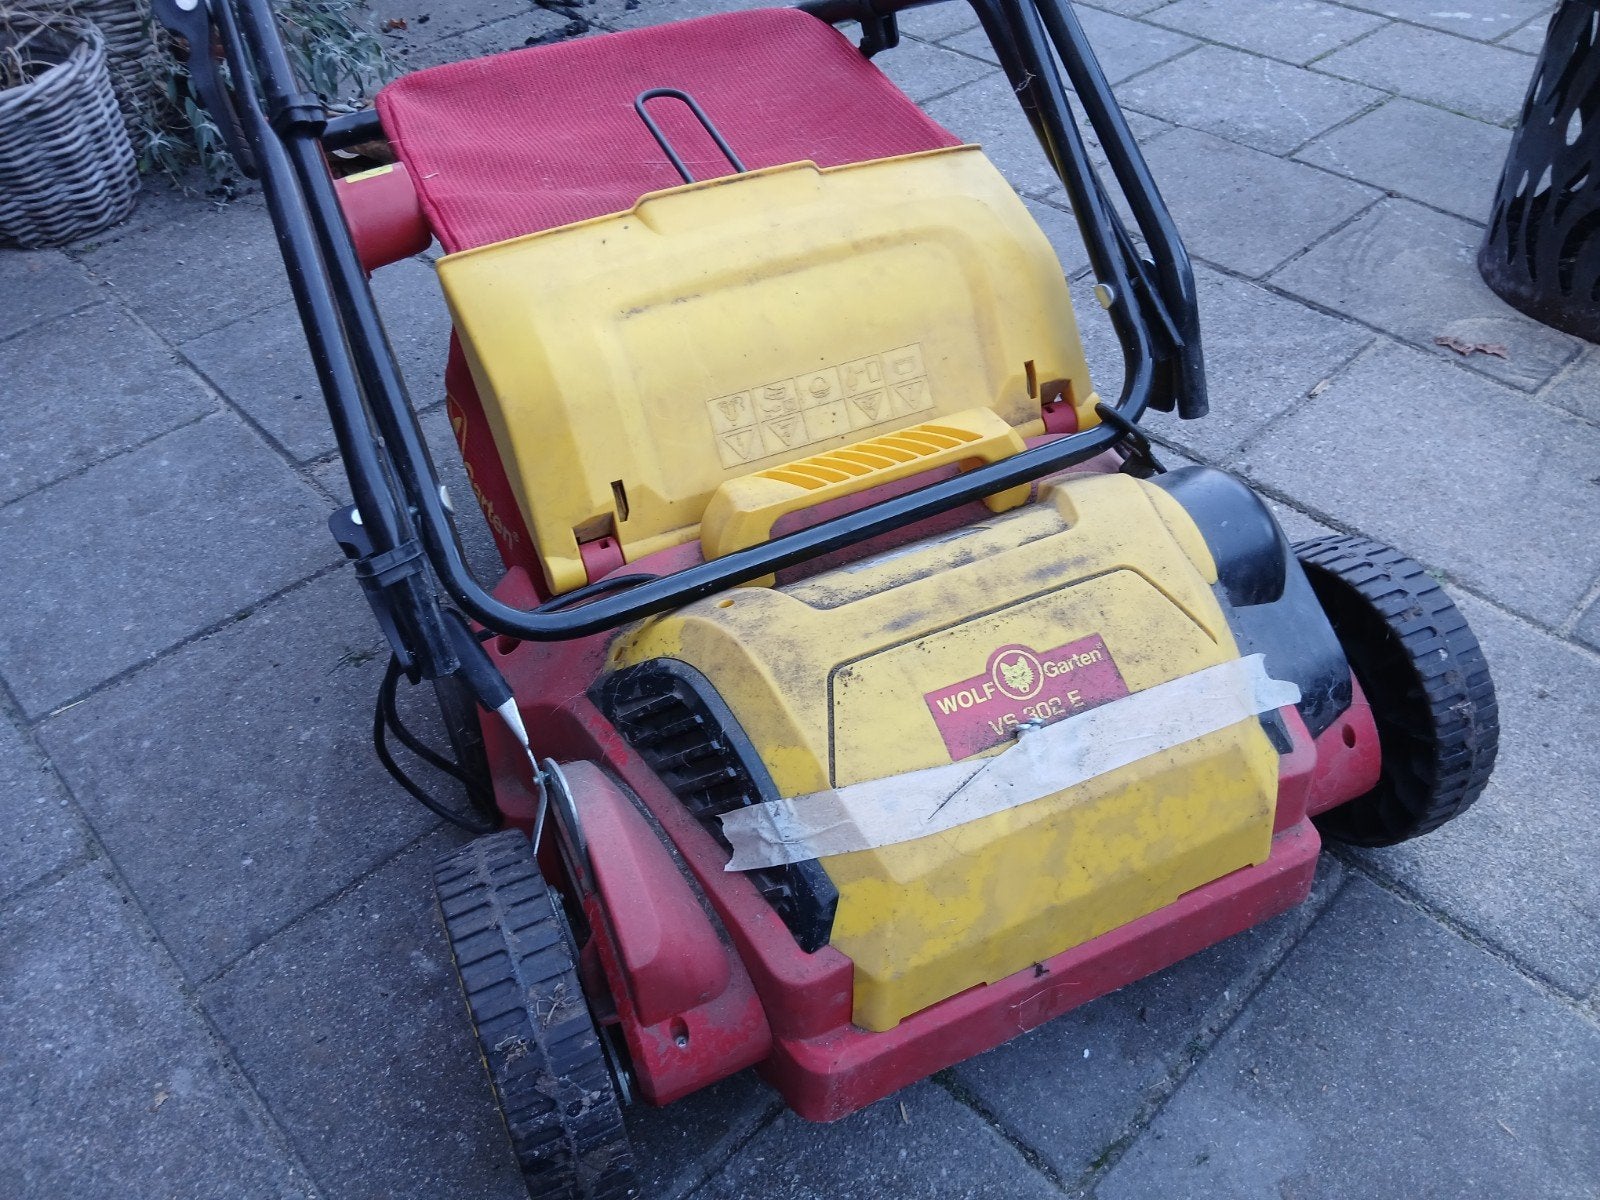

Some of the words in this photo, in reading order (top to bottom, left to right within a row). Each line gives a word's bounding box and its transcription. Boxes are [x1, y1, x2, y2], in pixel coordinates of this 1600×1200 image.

[936, 681, 996, 715] WOLF
[1043, 647, 1104, 678] Garten
[988, 713, 1020, 736] VS
[1022, 696, 1067, 721] 302
[1067, 689, 1086, 708] E
